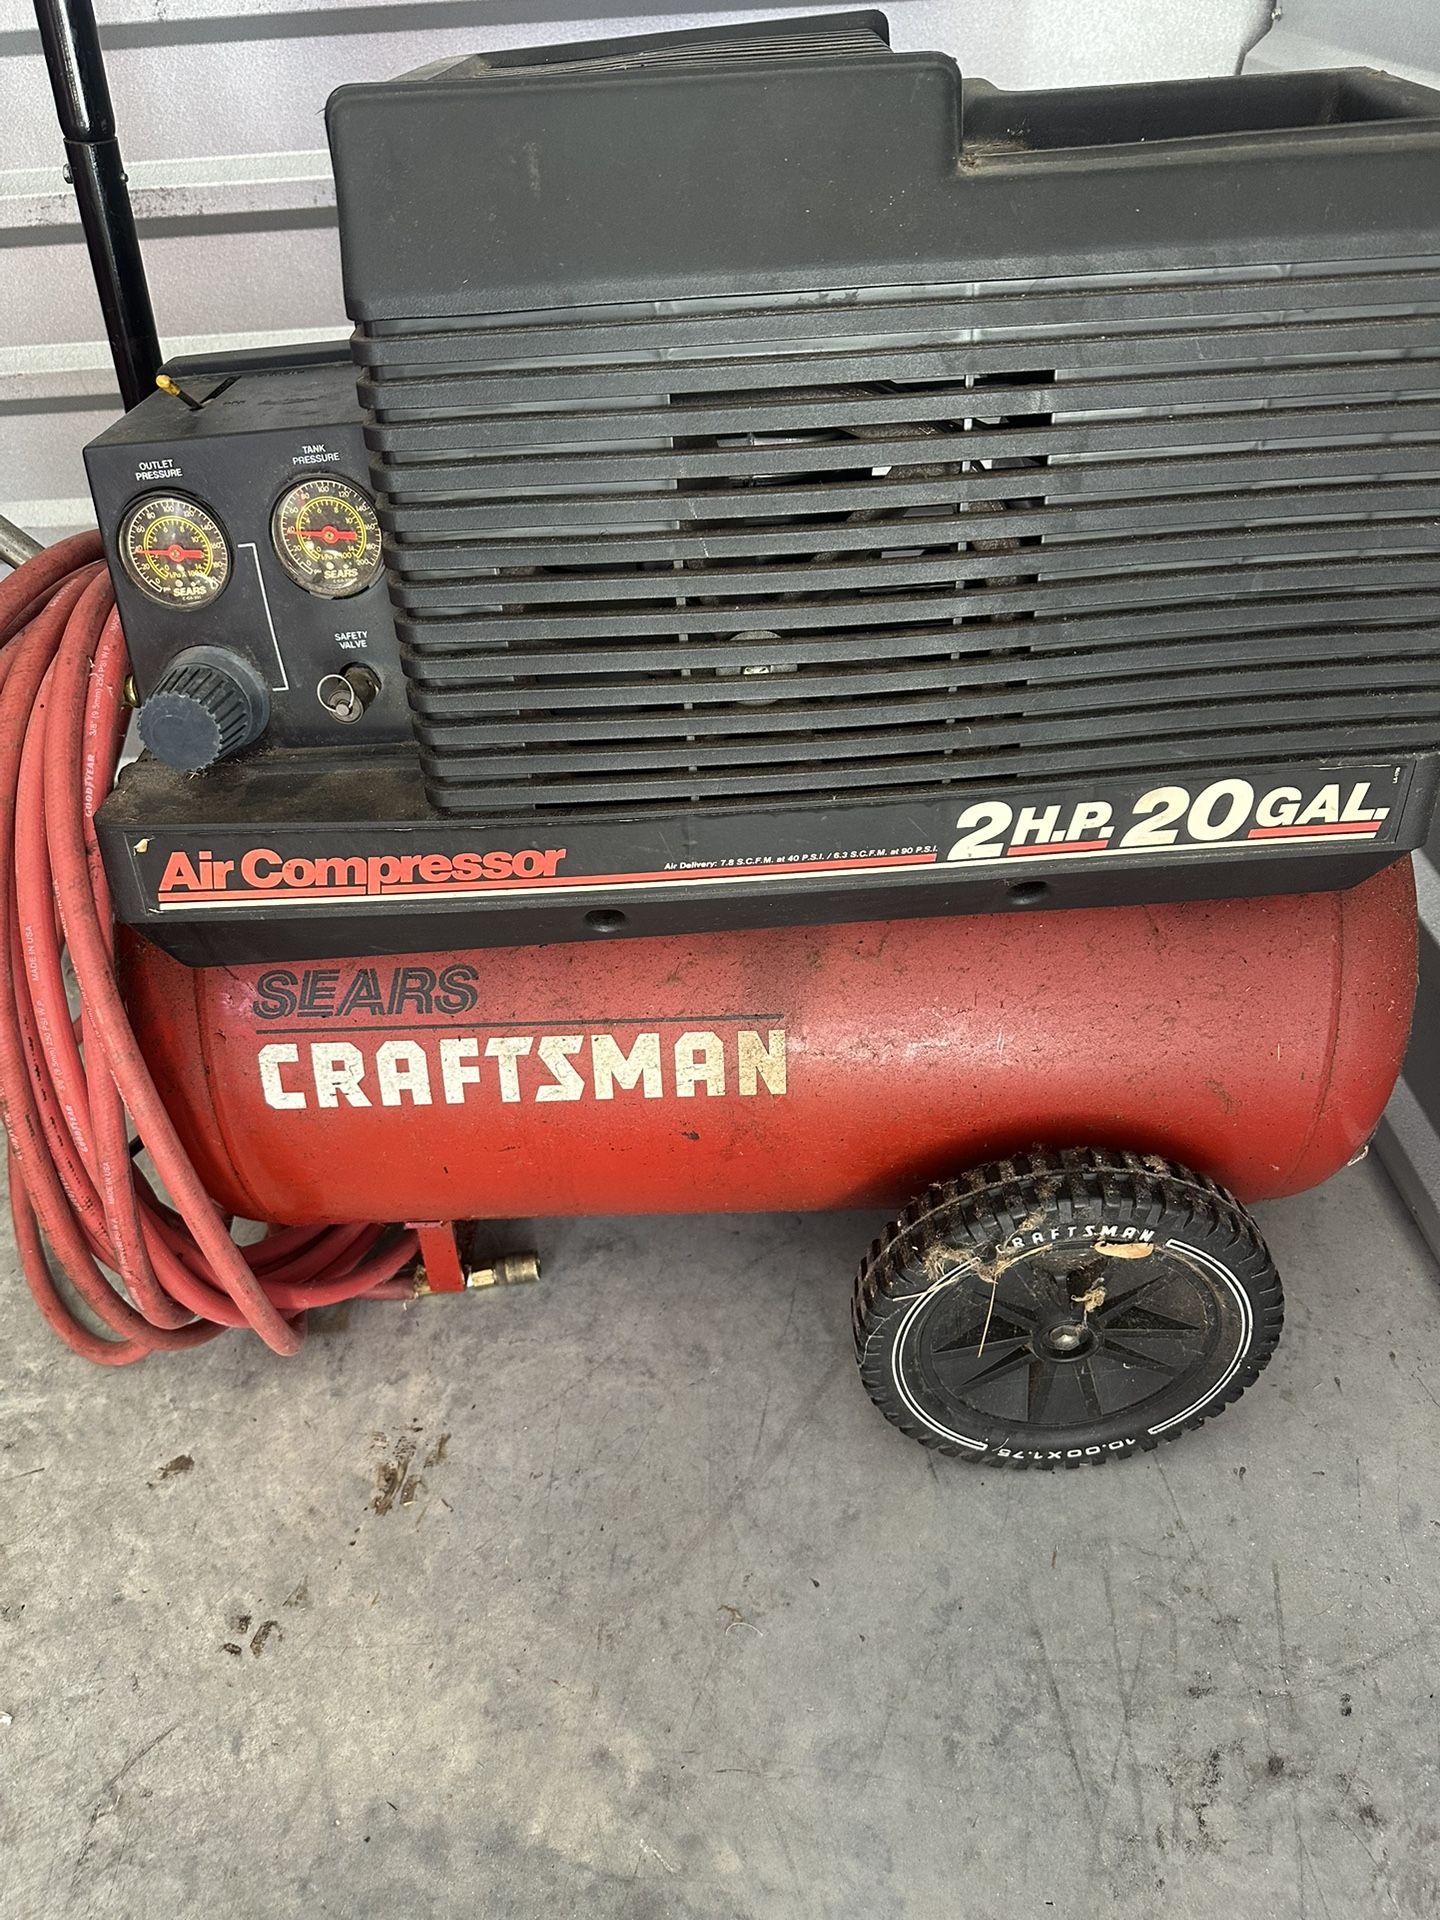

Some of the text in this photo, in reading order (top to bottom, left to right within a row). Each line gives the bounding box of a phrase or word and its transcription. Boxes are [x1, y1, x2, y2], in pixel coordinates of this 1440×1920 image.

[302, 444, 326, 454] TANK
[292, 452, 340, 465] PRESSURE
[138, 459, 174, 471] OUTLET
[135, 468, 183, 481] PRESSURE
[318, 485, 330, 493] 100
[338, 490, 350, 498] 120
[162, 505, 175, 513] 100
[324, 568, 358, 579] SEARS
[173, 586, 207, 597] SEARS
[334, 630, 368, 642] SAFETY
[338, 640, 368, 650] VALVE
[84, 754, 96, 818] GOODYEAR
[946, 777, 1391, 861] 2 H.P. 20 GAL.
[680, 861, 718, 870] Delivery:
[720, 858, 734, 866] 7.8
[736, 856, 774, 866] S.C.F.M.
[787, 854, 800, 862] 40
[801, 853, 825, 862] P.S.I.
[833, 851, 848, 860] 6.3
[850, 848, 888, 858] S.C.F.M.
[890, 848, 900, 856] at
[901, 846, 914, 854] 90
[915, 844, 938, 854] P.S.I.
[159, 848, 567, 895] Air Compressor
[25, 925, 34, 944] USA
[28, 946, 36, 956] IN
[32, 956, 40, 982] MADE
[252, 965, 480, 1020] SEARS
[257, 1029, 787, 1110] CRAFTSMAN
